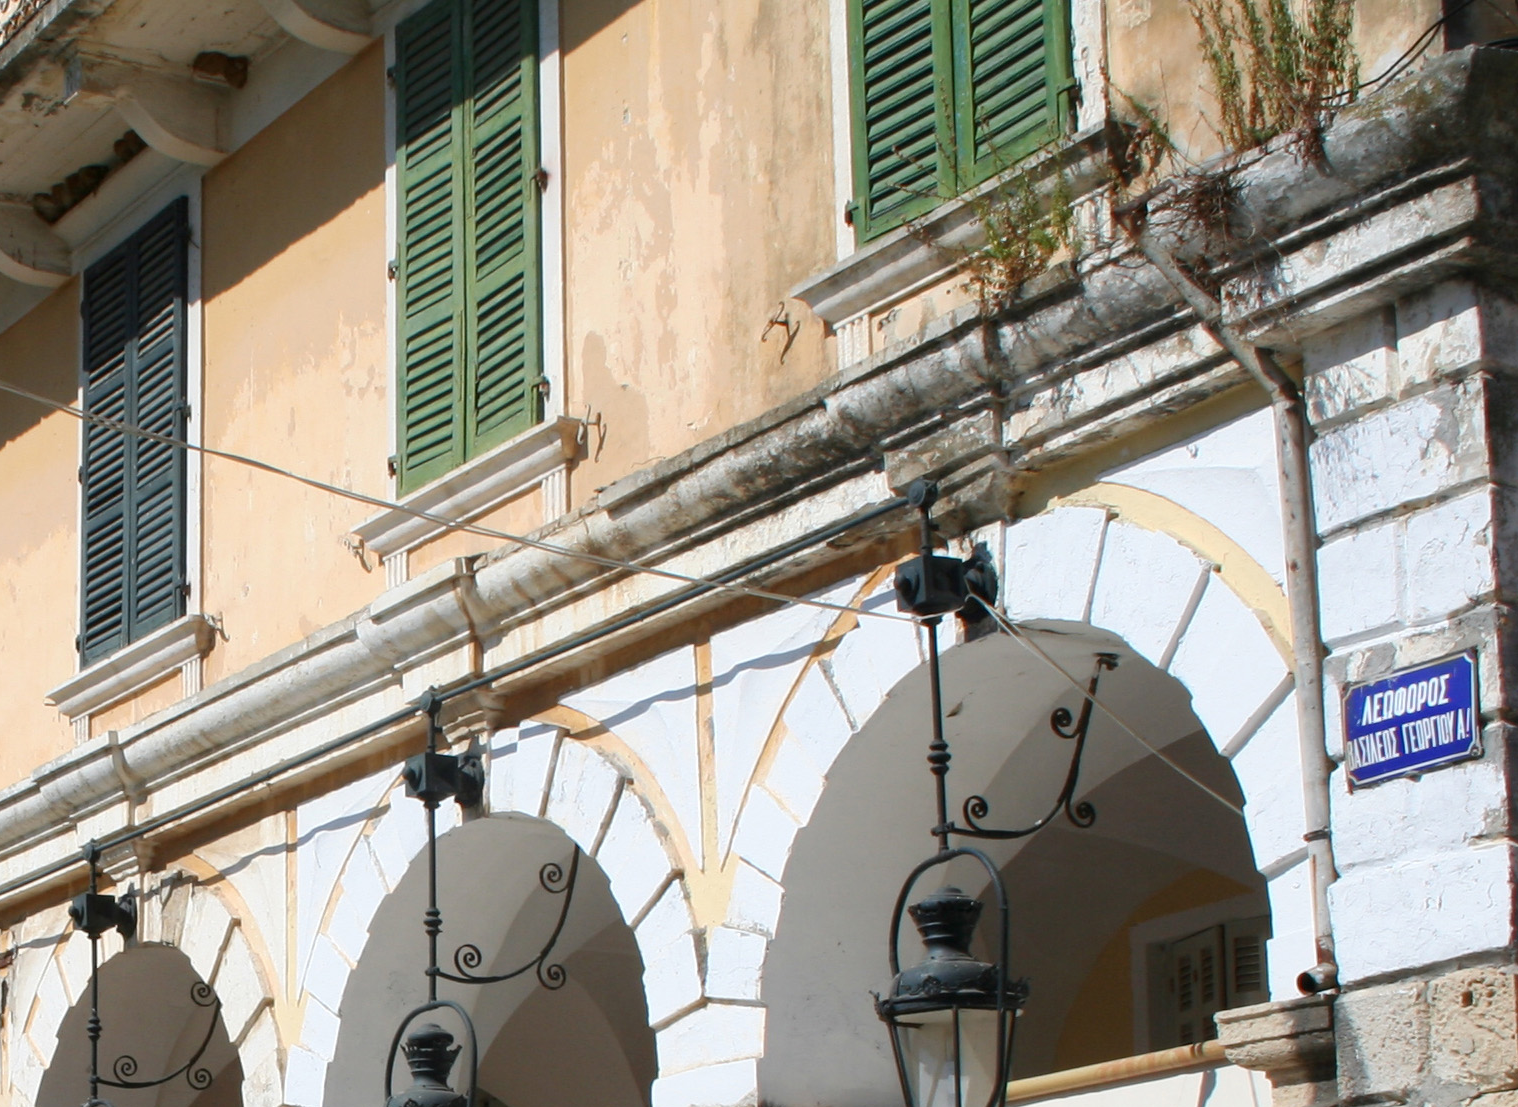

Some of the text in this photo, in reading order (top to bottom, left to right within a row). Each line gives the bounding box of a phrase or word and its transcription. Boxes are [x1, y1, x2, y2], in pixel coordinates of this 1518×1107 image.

[1361, 673, 1450, 726] ΛΕΩΦΟΡΟΣ
[1346, 727, 1400, 771] ΒΑΣΙΛΕΩΣ
[1401, 711, 1455, 755] ΓΕΩΡΓΙΟΥ
